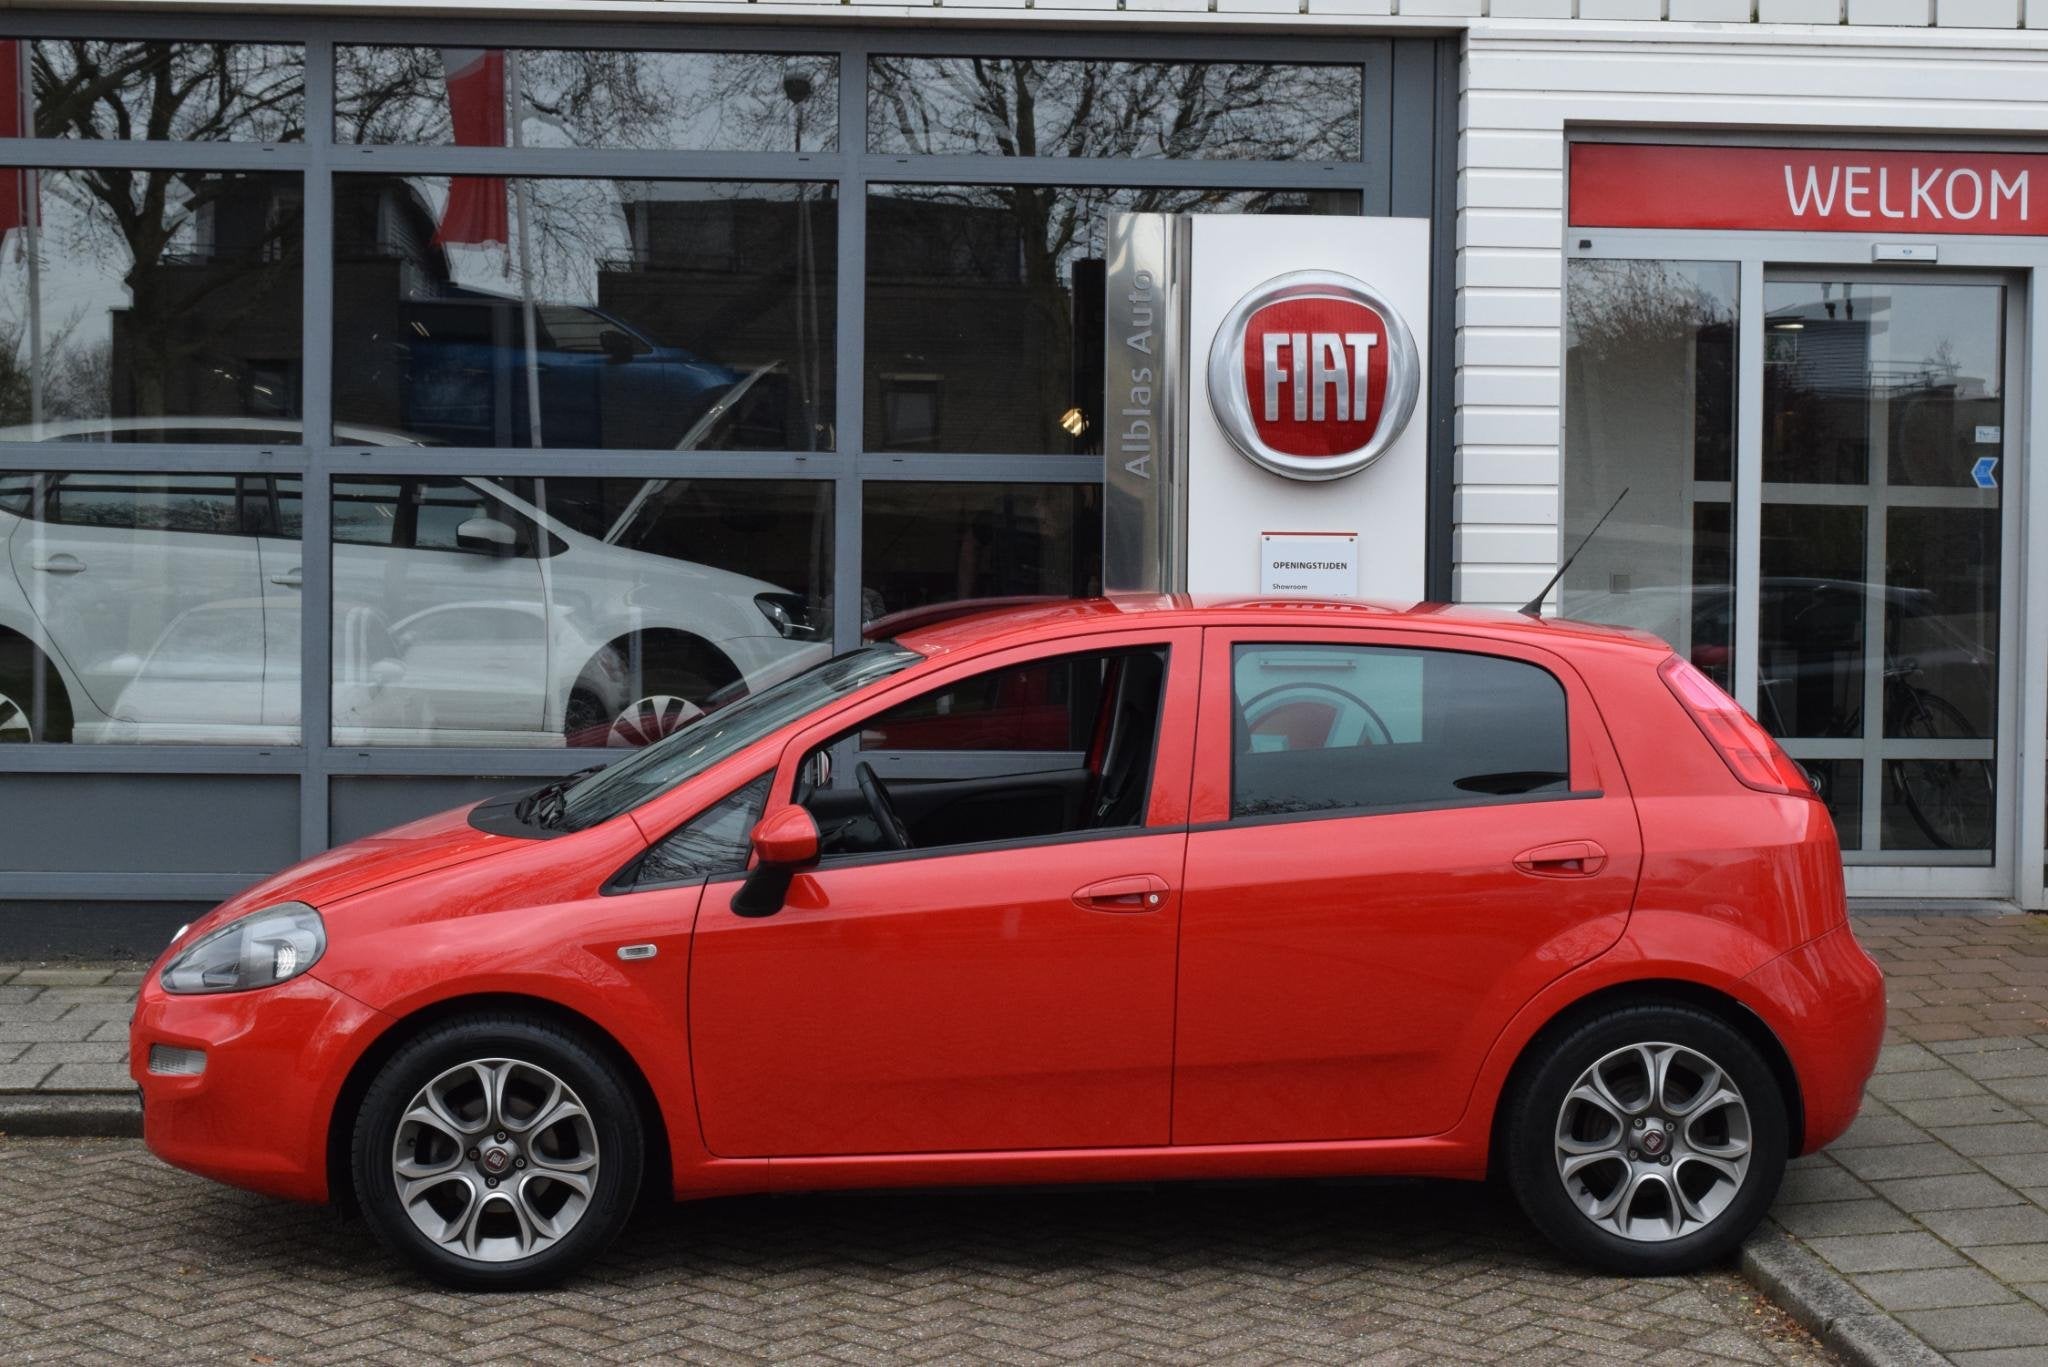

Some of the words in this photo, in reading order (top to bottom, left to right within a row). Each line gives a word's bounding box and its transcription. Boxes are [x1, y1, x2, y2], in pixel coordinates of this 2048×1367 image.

[1784, 165, 2029, 220] WELKOM
[1126, 269, 1153, 355] Auto
[1262, 333, 1378, 422] FIAT
[1121, 367, 1153, 479] Alblas
[1272, 561, 1348, 570] OPENINGSTIJDEN
